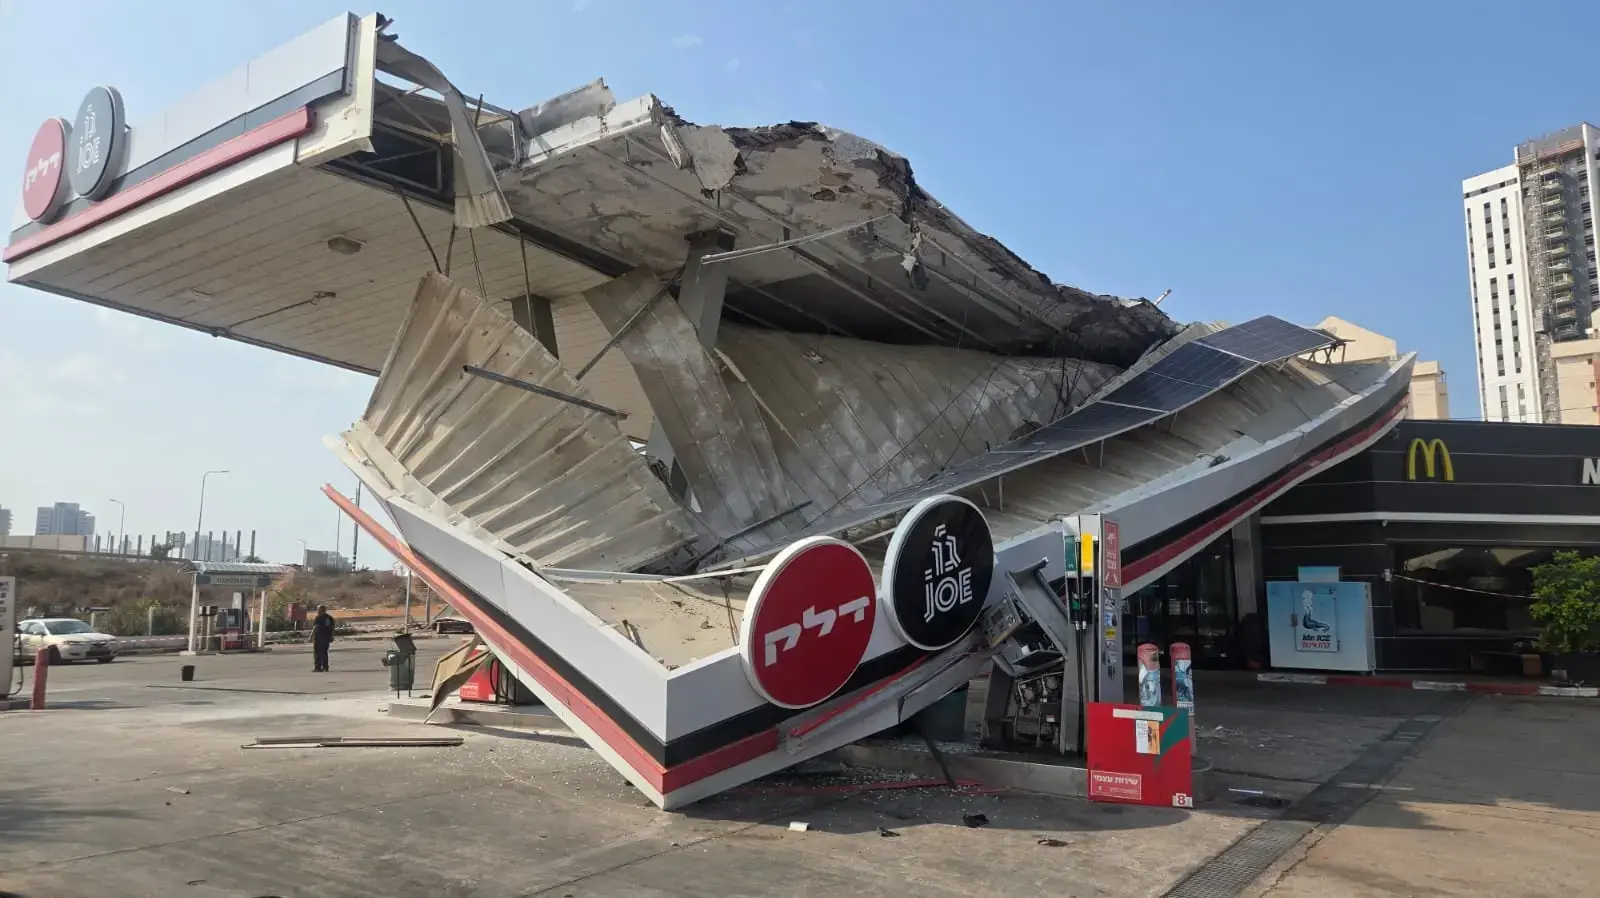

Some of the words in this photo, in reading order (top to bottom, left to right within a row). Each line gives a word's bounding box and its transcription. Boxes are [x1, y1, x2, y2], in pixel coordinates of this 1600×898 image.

[25, 151, 60, 191] דלק
[77, 136, 101, 175] JOE
[924, 567, 973, 623] JOE
[764, 595, 870, 668] דלק
[1093, 774, 1113, 784] עצמי
[1114, 776, 1138, 786] שירות
[1177, 795, 1186, 805] 8
